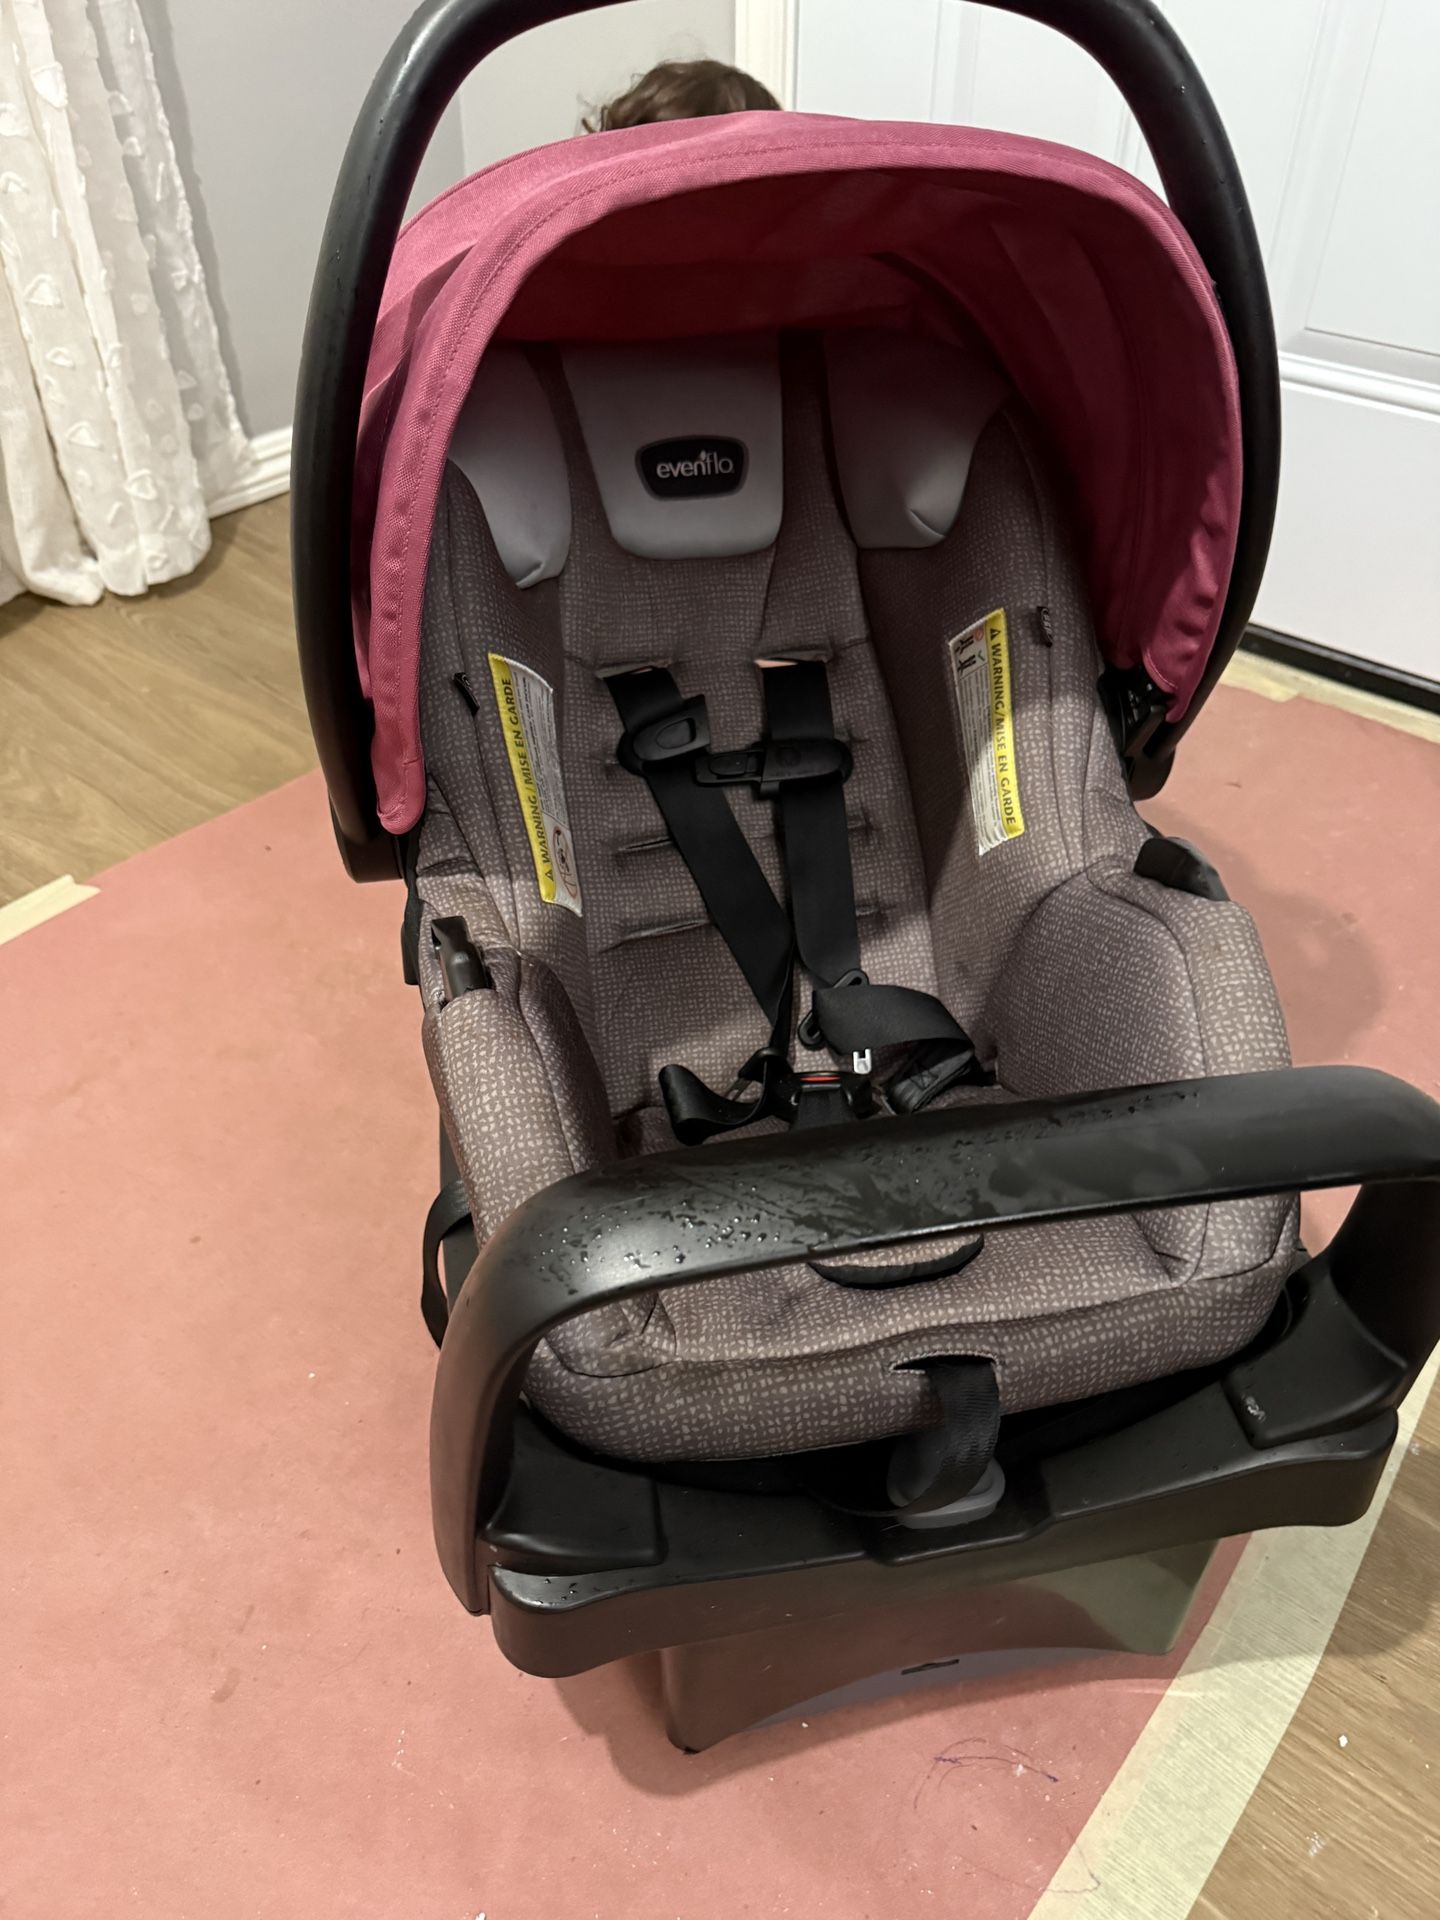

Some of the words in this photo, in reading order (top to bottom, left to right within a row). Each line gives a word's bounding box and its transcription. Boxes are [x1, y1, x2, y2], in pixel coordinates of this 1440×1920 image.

[656, 450, 734, 479] evenflo
[502, 678, 519, 726] GARDE
[513, 730, 525, 748] EN
[518, 751, 534, 785] MISE
[997, 755, 1009, 773] EN
[1000, 777, 1017, 825] GARDE
[528, 795, 551, 864] WARNING
